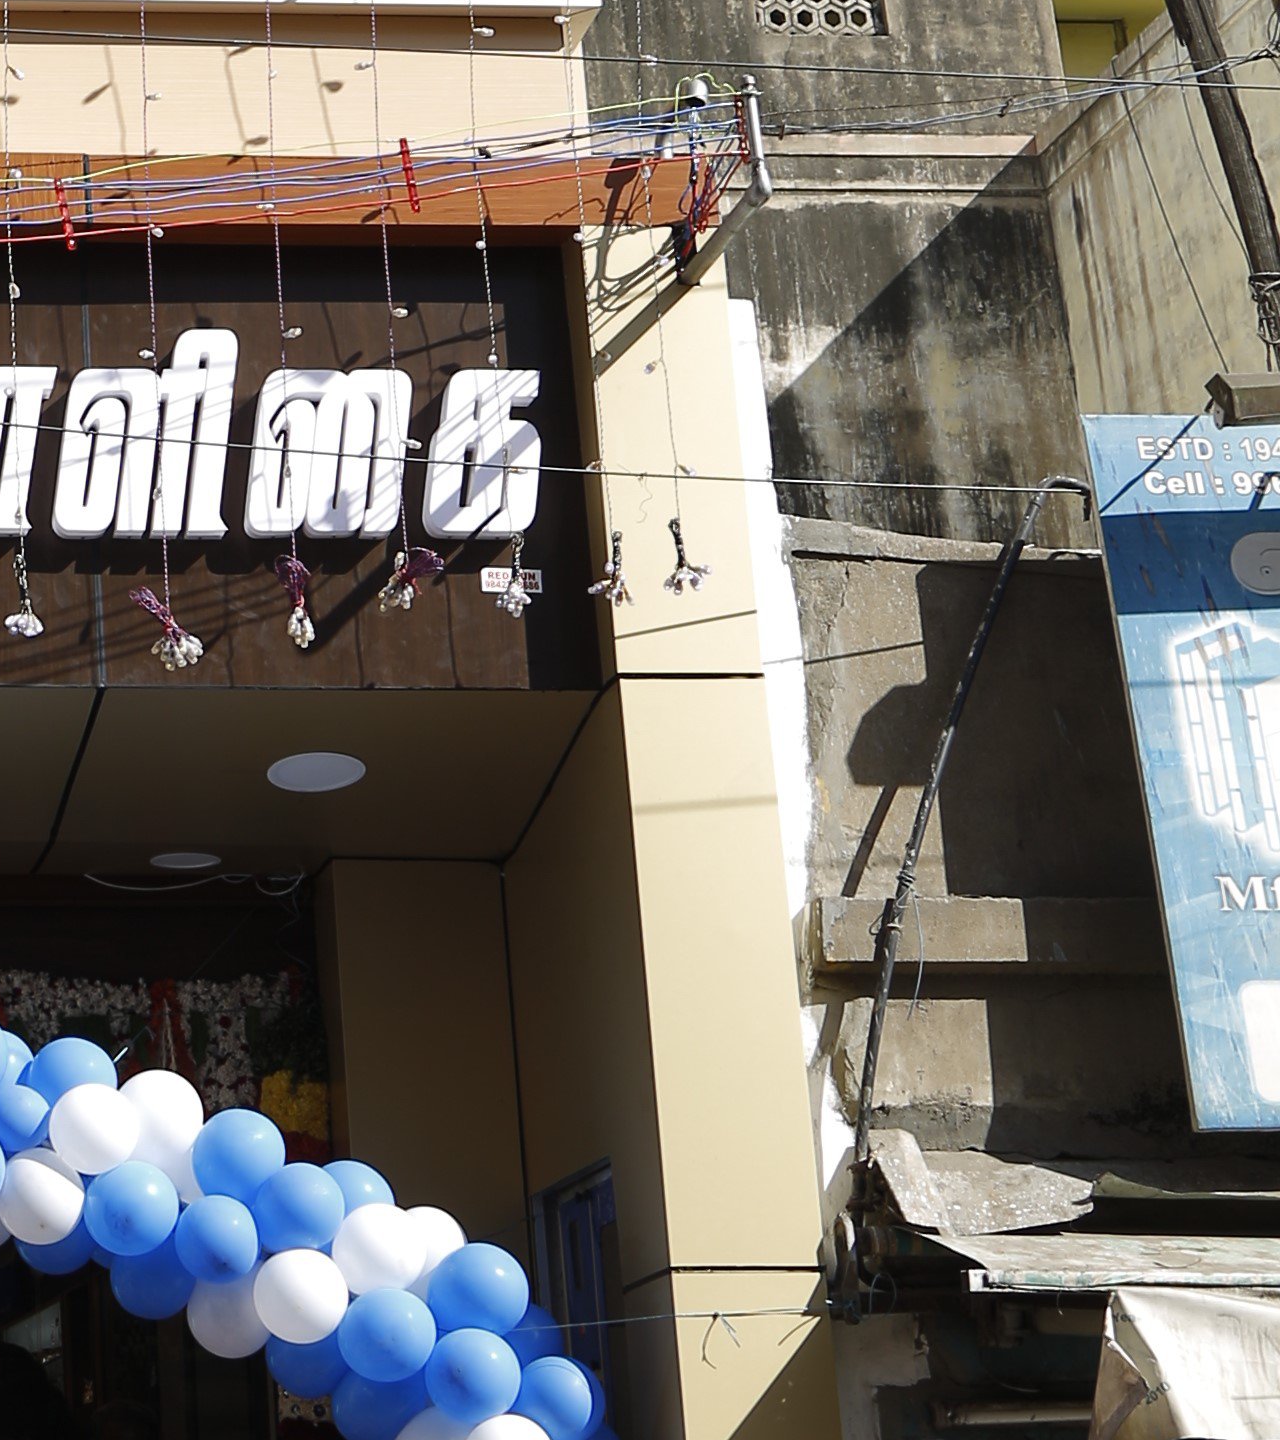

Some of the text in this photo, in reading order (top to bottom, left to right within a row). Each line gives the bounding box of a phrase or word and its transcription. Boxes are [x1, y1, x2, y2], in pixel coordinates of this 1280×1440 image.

[1136, 436, 1214, 462] ESTD
[1222, 442, 1233, 461] :
[1144, 470, 1206, 496] Cell
[1214, 475, 1225, 495] :
[487, 571, 510, 580] RED
